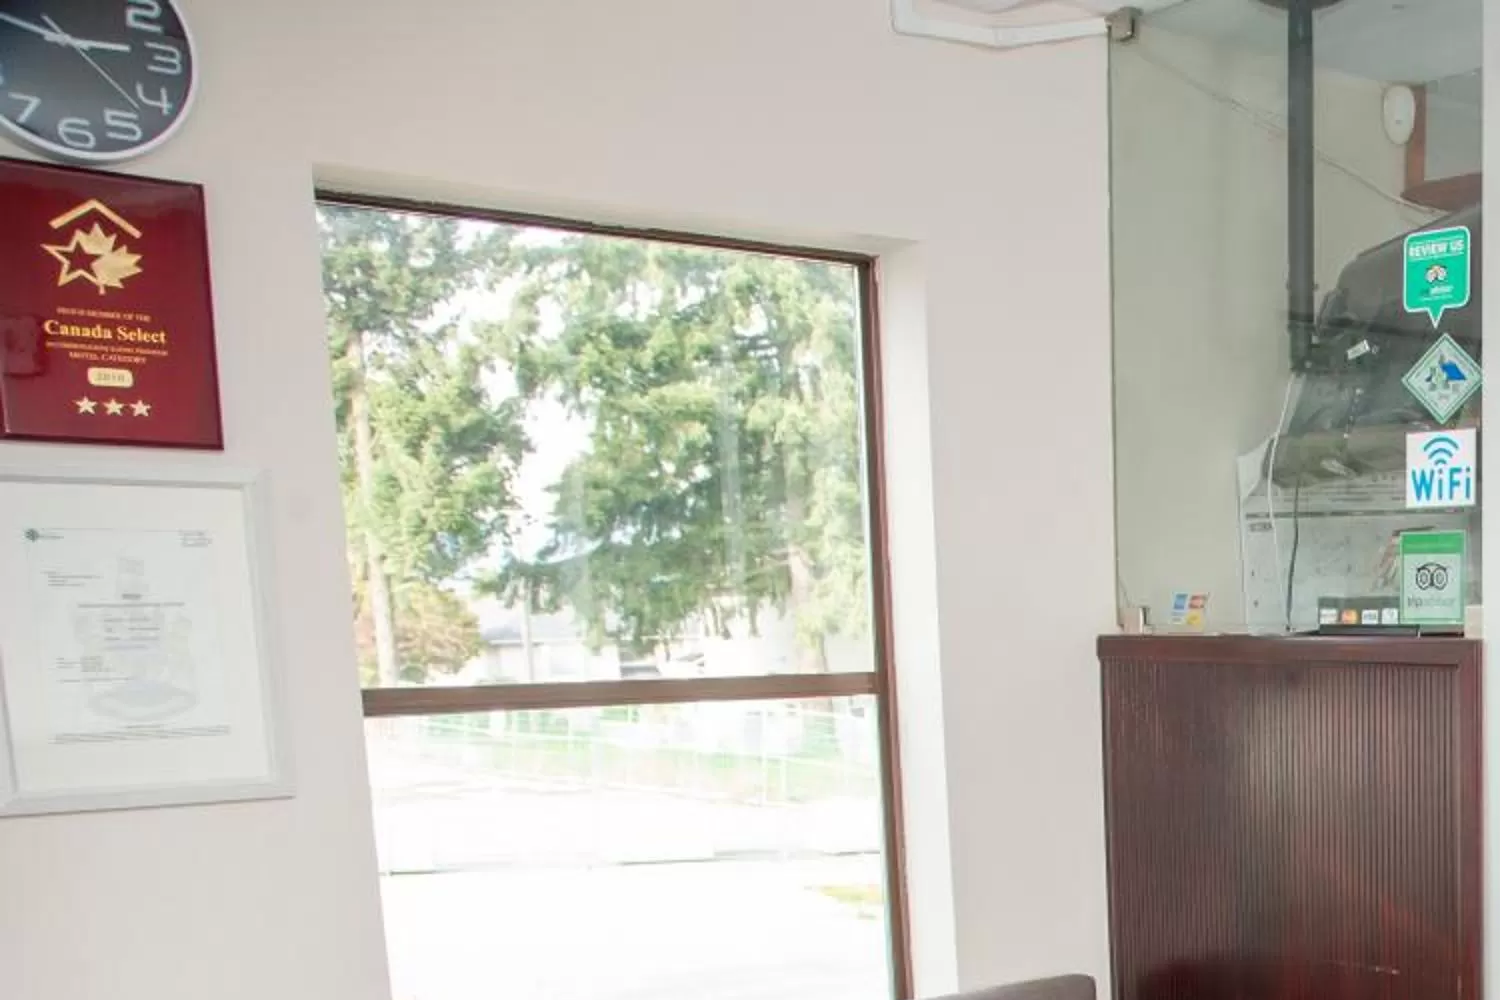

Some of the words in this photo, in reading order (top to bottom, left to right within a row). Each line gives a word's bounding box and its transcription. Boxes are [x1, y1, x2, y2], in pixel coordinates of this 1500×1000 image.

[126, 0, 163, 33] 2
[144, 41, 182, 75] 3
[8, 92, 42, 123] 7
[136, 82, 172, 116] 4
[57, 117, 96, 149] 6
[103, 108, 142, 142] 5
[1408, 241, 1448, 257] REVIEW
[1450, 238, 1465, 252] US
[43, 319, 113, 340] Canada
[116, 325, 167, 345] Select
[1411, 467, 1471, 501] WiFi
